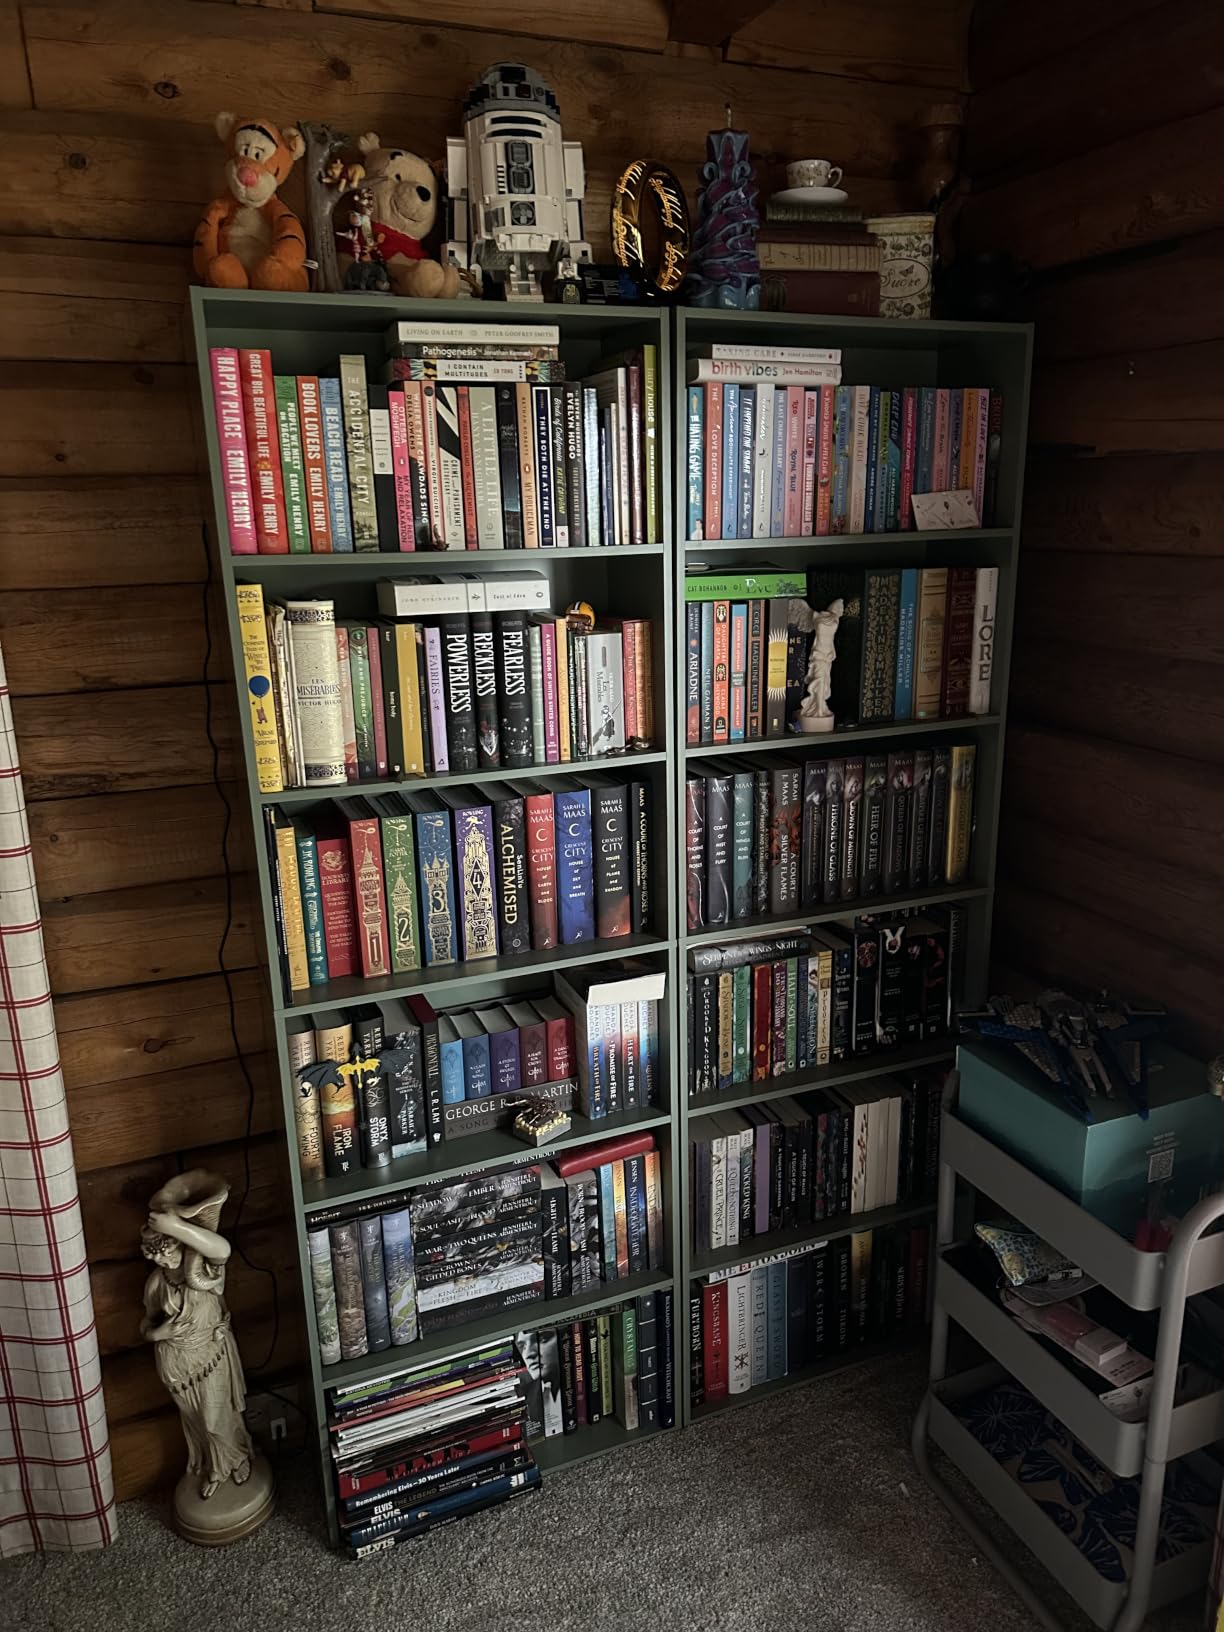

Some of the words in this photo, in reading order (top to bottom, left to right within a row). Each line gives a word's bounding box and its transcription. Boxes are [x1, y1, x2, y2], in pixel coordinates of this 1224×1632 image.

[406, 328, 429, 336] LIVING
[422, 345, 477, 357] Pathogenesis
[217, 357, 239, 397] HAPPY
[249, 353, 262, 379] GREAT
[712, 361, 742, 375] birth
[745, 363, 778, 377] vibes
[795, 369, 822, 377] Hamilton
[251, 380, 264, 395] BIG
[302, 383, 318, 414] BOOK
[221, 401, 242, 438] PLACE
[253, 397, 268, 440] BEAUTIFUL
[287, 402, 298, 432] PEOPLE
[567, 392, 575, 429] EVELYN
[325, 407, 341, 447] BEACH
[349, 390, 368, 467] ACCIDENTAL
[391, 401, 401, 448] MOSHFEGH
[539, 416, 547, 435] THEY
[257, 441, 270, 458] LIFE
[281, 422, 292, 462] VACATION
[304, 417, 321, 460] LOVERS
[540, 437, 548, 466] BOTH
[568, 430, 577, 460] HUGO
[226, 450, 248, 487] EMILY
[291, 448, 301, 470] MEET
[329, 451, 344, 482] READ
[541, 465, 549, 480] DIE
[259, 470, 276, 501] EMILY
[289, 473, 300, 502] EMILY
[309, 467, 324, 498] EMILY
[355, 475, 370, 504] CITY
[231, 491, 251, 529] HENRY
[334, 487, 345, 513] EMILY
[420, 502, 429, 524] SING
[452, 489, 462, 528] PUNISHMENT
[263, 503, 279, 535] HENRY
[292, 504, 304, 536] HENRY
[312, 501, 327, 533] HENRY
[336, 513, 348, 538] HENRY
[399, 494, 408, 543] RELAXATION
[525, 495, 535, 536] POLICEMAN
[745, 578, 772, 594] Eve
[978, 605, 993, 681] LORE
[429, 655, 440, 694] FAIRIES
[447, 634, 472, 713] POWERLESS
[473, 632, 497, 697] RECKLESS
[503, 631, 526, 696] FEARLESS
[751, 642, 759, 682] MADELINE
[689, 651, 699, 701] ARIADNE
[704, 689, 712, 720] GAIMAN
[711, 785, 730, 793] MAAS
[734, 782, 753, 790] MAAS
[781, 781, 790, 806] MAAS
[791, 773, 799, 801] SARAH
[462, 809, 484, 817] ROWLING
[530, 813, 553, 824] MAAS
[563, 810, 586, 819] MAAS
[600, 805, 623, 814] MAAS
[830, 803, 840, 841] THRONE
[871, 805, 881, 831] HEIR
[564, 841, 587, 850] CRESCENT
[564, 848, 588, 858] CITY
[601, 836, 624, 844] CRESCENT
[601, 842, 624, 853] CITY
[780, 834, 789, 865] SILVER
[531, 852, 554, 863] CITY
[828, 854, 837, 882] GLASS
[846, 840, 856, 878] MIDNIGHT
[868, 847, 878, 871] FIRE
[303, 859, 316, 893] ROWLING
[322, 878, 350, 886] LIBRARY
[472, 868, 483, 889] 4
[501, 823, 518, 925] ALCHEMISED
[779, 866, 788, 902] FLAMES
[432, 890, 445, 913] 3
[399, 916, 410, 941] 2
[371, 937, 378, 964] 1
[775, 939, 799, 950] NIGHT
[703, 992, 712, 1034] CROOKED
[608, 1044, 616, 1076] PROMISE
[627, 1039, 635, 1066] HEART
[703, 1035, 711, 1079] KINGDOM
[609, 1081, 617, 1100] FIRE
[446, 1100, 496, 1121] GEORGE
[342, 1127, 353, 1149] IRON
[369, 1116, 379, 1148] STORM
[377, 1116, 389, 1142] ONYX
[459, 1120, 489, 1131] SONG
[301, 1134, 311, 1157] WING
[310, 1127, 321, 1160] FOURTH
[332, 1124, 345, 1157] FLAME
[468, 1185, 496, 1198] EMBER
[498, 1177, 537, 1191] ARMENTROUT
[715, 1173, 724, 1200] CRUEL
[417, 1196, 453, 1210] SHADOW
[499, 1200, 538, 1214] ARMENTROUT
[715, 1200, 725, 1231] PRINCE
[728, 1200, 736, 1231] NOTHING
[743, 1198, 752, 1220] KING
[419, 1223, 439, 1233] SOUL
[446, 1218, 462, 1227] ASH
[499, 1224, 538, 1238] ARMENTROUT
[424, 1246, 443, 1256] WAR
[467, 1232, 497, 1245] QUEENS
[425, 1268, 456, 1283] GILDED
[456, 1263, 482, 1276] BONES
[440, 1260, 471, 1272] CROWN
[503, 1292, 541, 1307] ARMENTROUT
[755, 1284, 764, 1311] RED
[690, 1298, 701, 1352] FURYBORN
[710, 1291, 722, 1347] KINGSBANE
[736, 1285, 747, 1351] LIGHTBRINGER
[815, 1303, 825, 1344] STORM
[754, 1324, 764, 1372] QUEEN
[355, 1487, 398, 1508] Remembering
[427, 1472, 444, 1482] Years
[443, 1465, 461, 1477] Later
[373, 1501, 394, 1515] ELVIS
[405, 1487, 437, 1502] LEGEND
[370, 1508, 402, 1525] ELVIS
[355, 1537, 396, 1560] ELVIS
